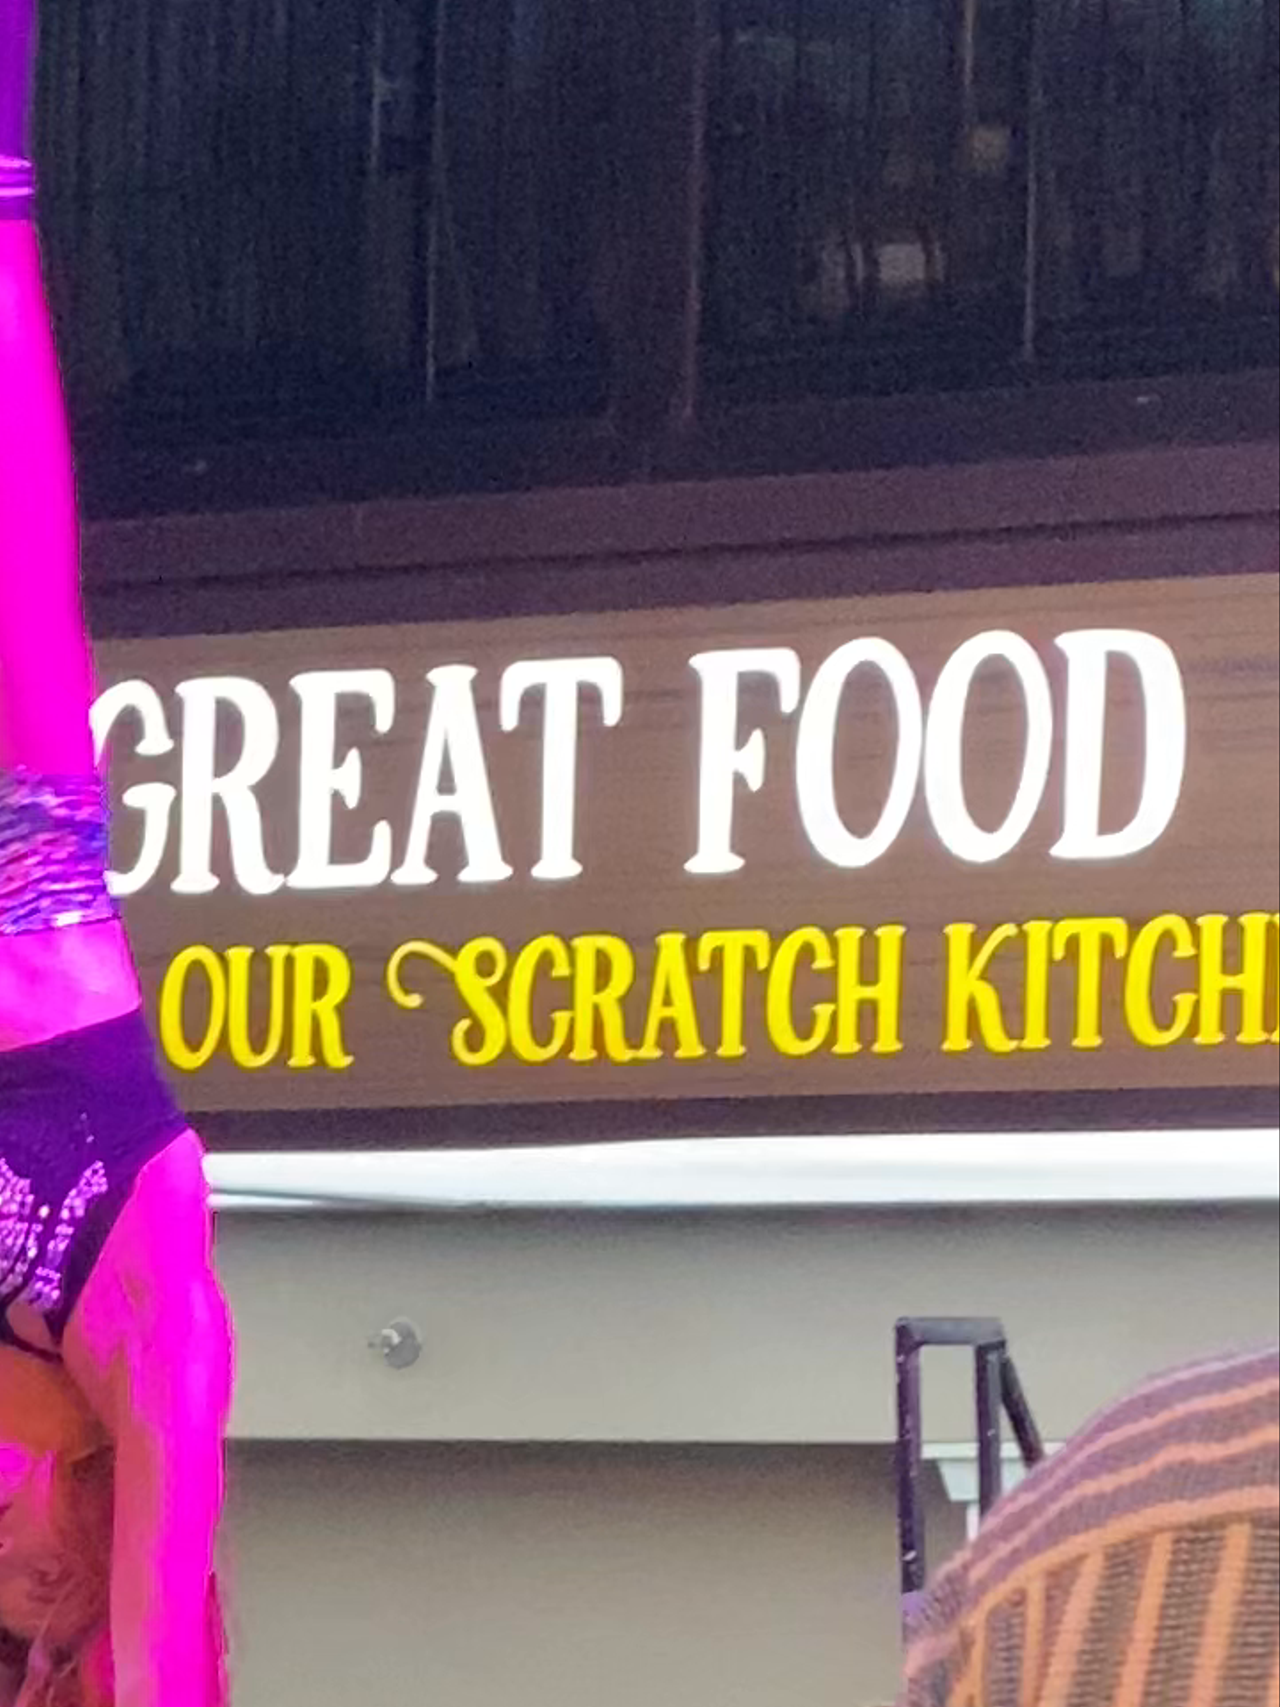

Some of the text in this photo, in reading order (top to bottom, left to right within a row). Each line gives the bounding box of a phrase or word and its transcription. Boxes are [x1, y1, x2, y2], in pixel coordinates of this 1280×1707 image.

[89, 627, 1188, 896] GREAT FOOD
[159, 910, 1280, 1070] OUR SCRATCH KITCH
